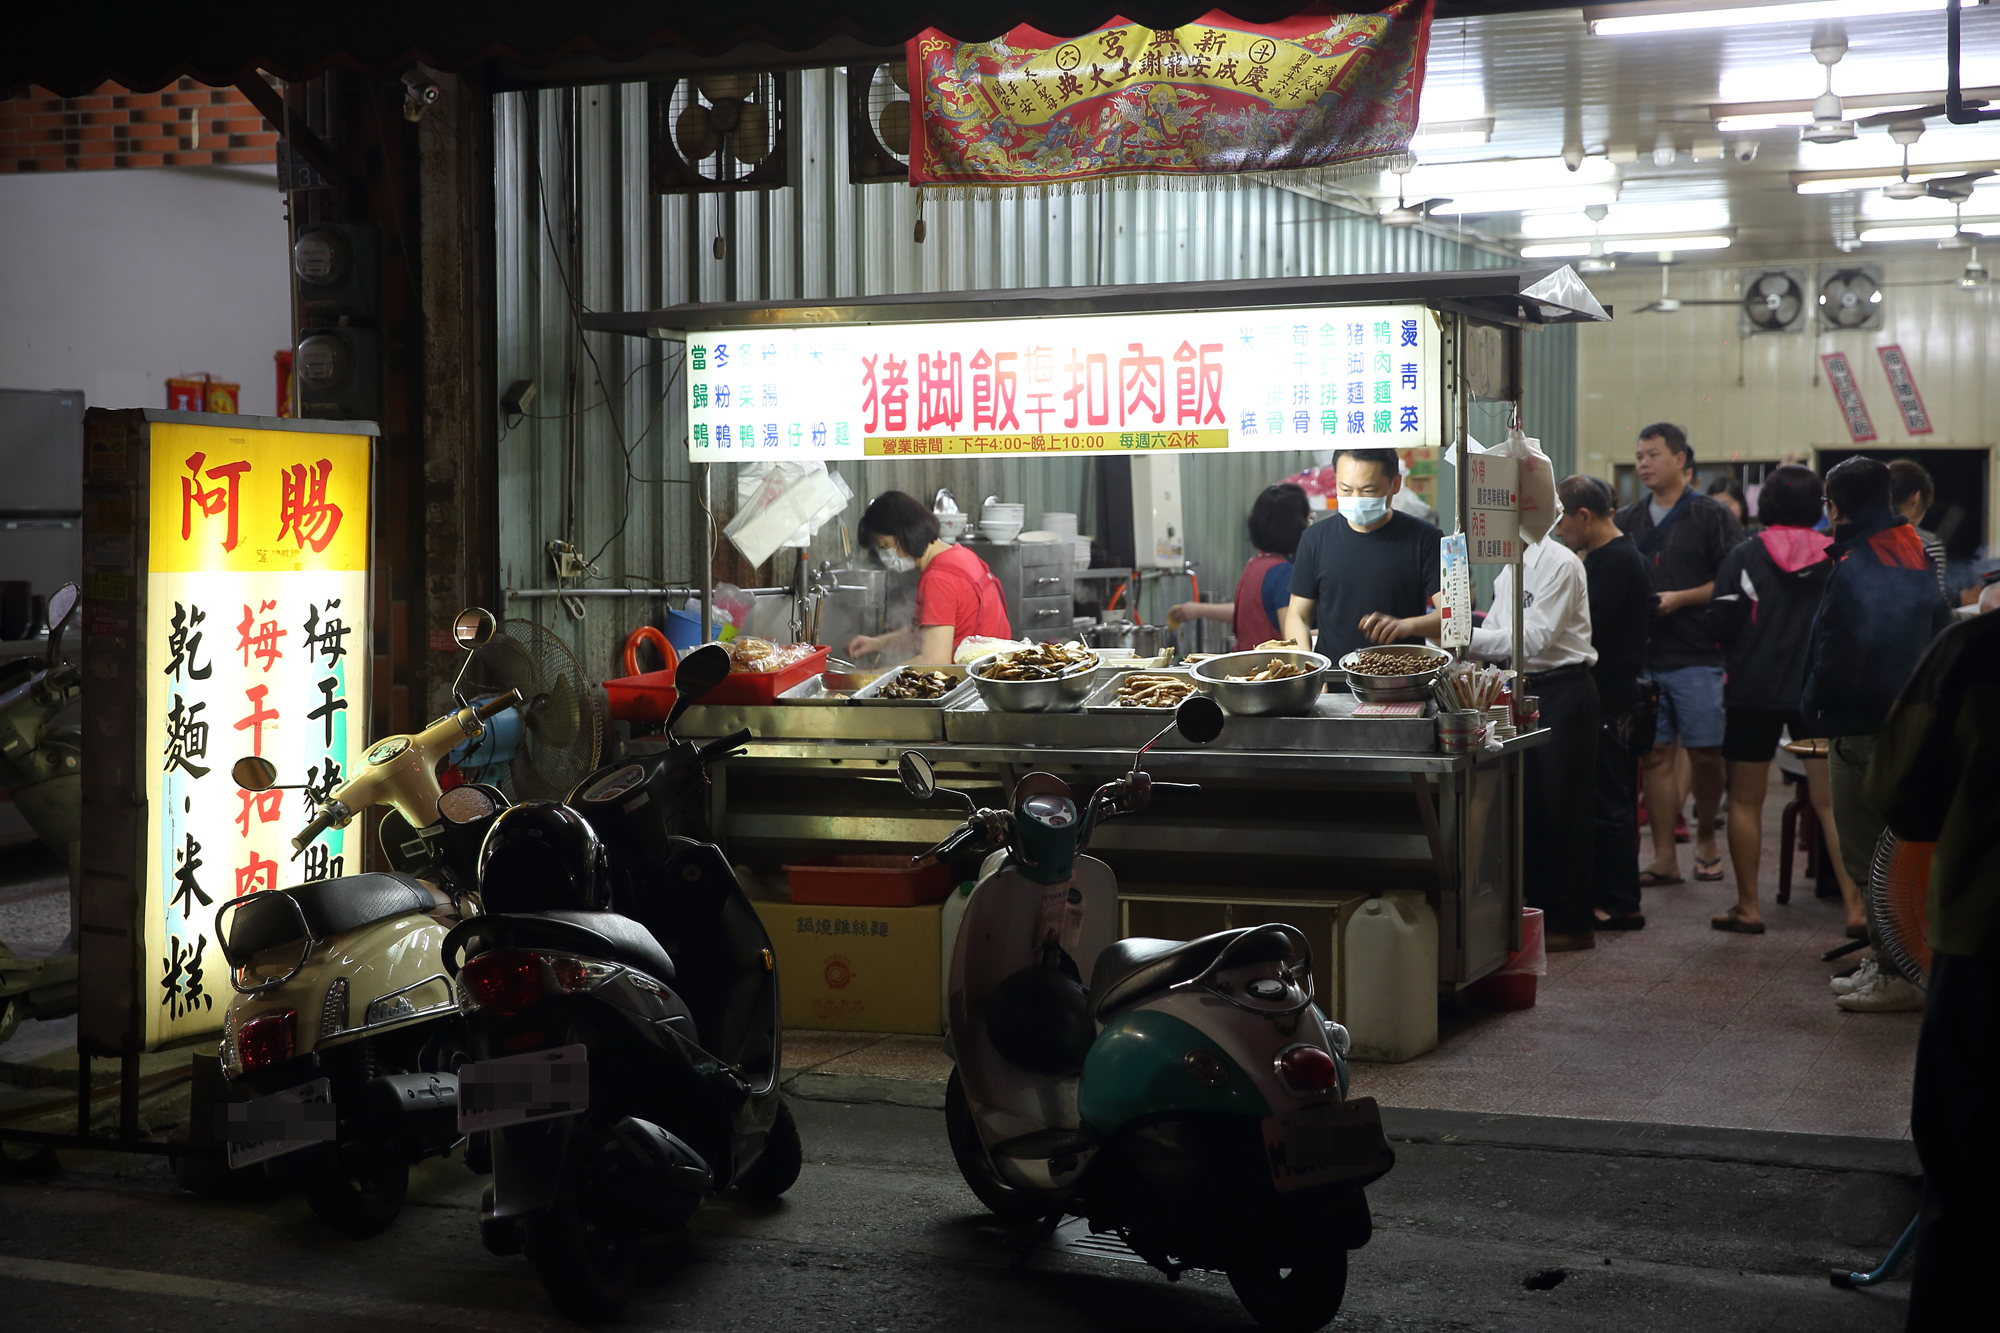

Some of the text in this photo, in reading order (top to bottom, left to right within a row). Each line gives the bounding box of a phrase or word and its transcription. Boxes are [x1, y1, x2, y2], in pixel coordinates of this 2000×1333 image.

[691, 344, 709, 449] 當歸鴨
[714, 344, 732, 449] 冬粉鴨
[1373, 320, 1392, 433] 鴨肉麵線
[1119, 431, 1199, 449] 每週六公休
[1472, 459, 1485, 484] 外帶
[796, 917, 888, 937] 鍋燒雞絲麵
